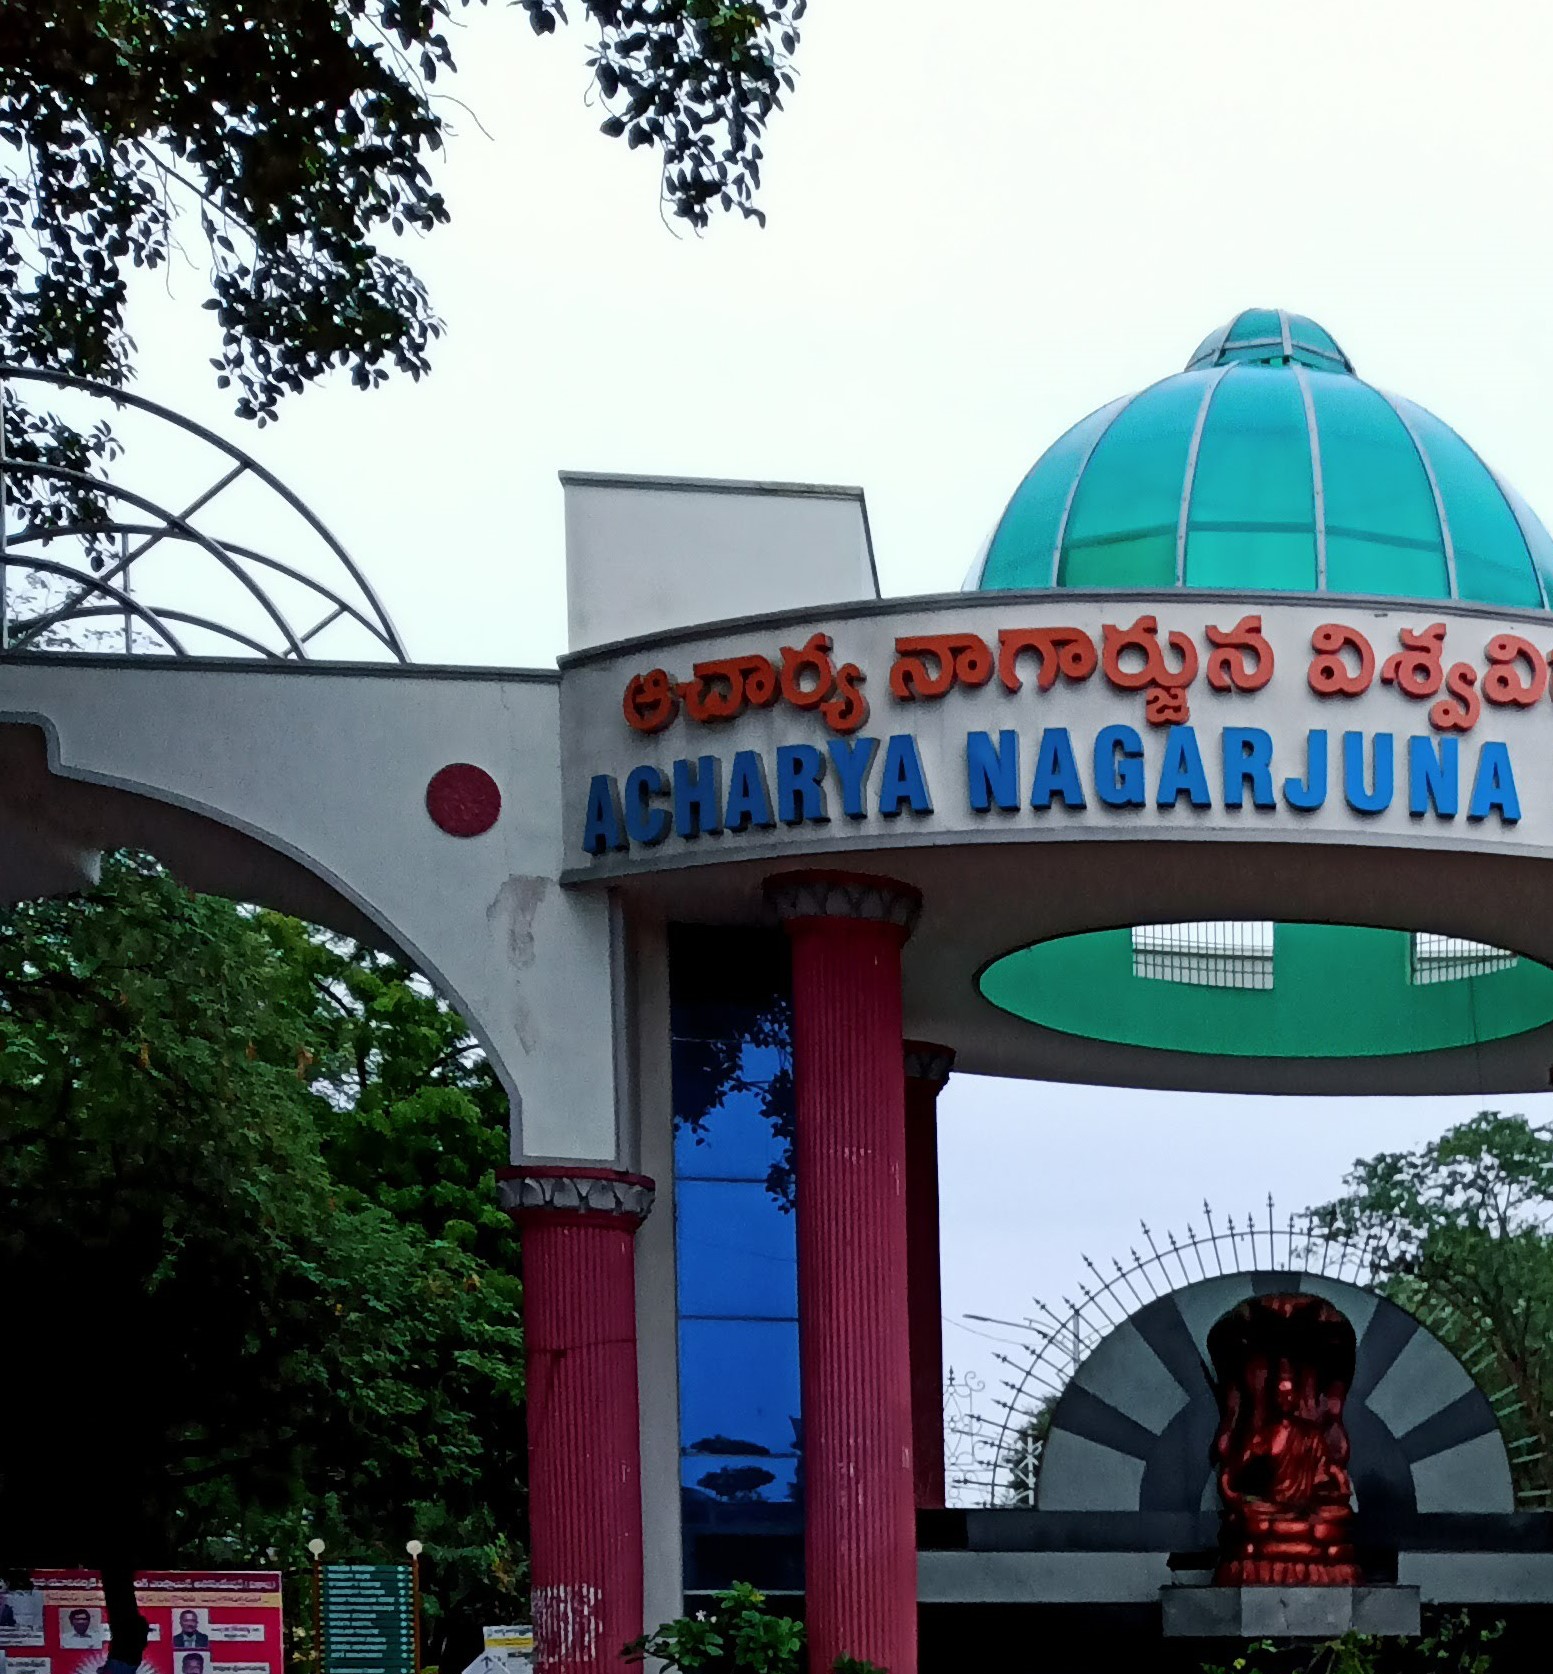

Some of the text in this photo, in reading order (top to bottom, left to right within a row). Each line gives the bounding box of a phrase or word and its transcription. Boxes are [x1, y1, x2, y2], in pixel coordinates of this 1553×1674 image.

[622, 632, 872, 736] ఆచార్య
[886, 614, 1276, 727] నాగార్జున
[582, 733, 935, 858] ACHARYA
[965, 722, 1524, 827] NAGARJUNA
